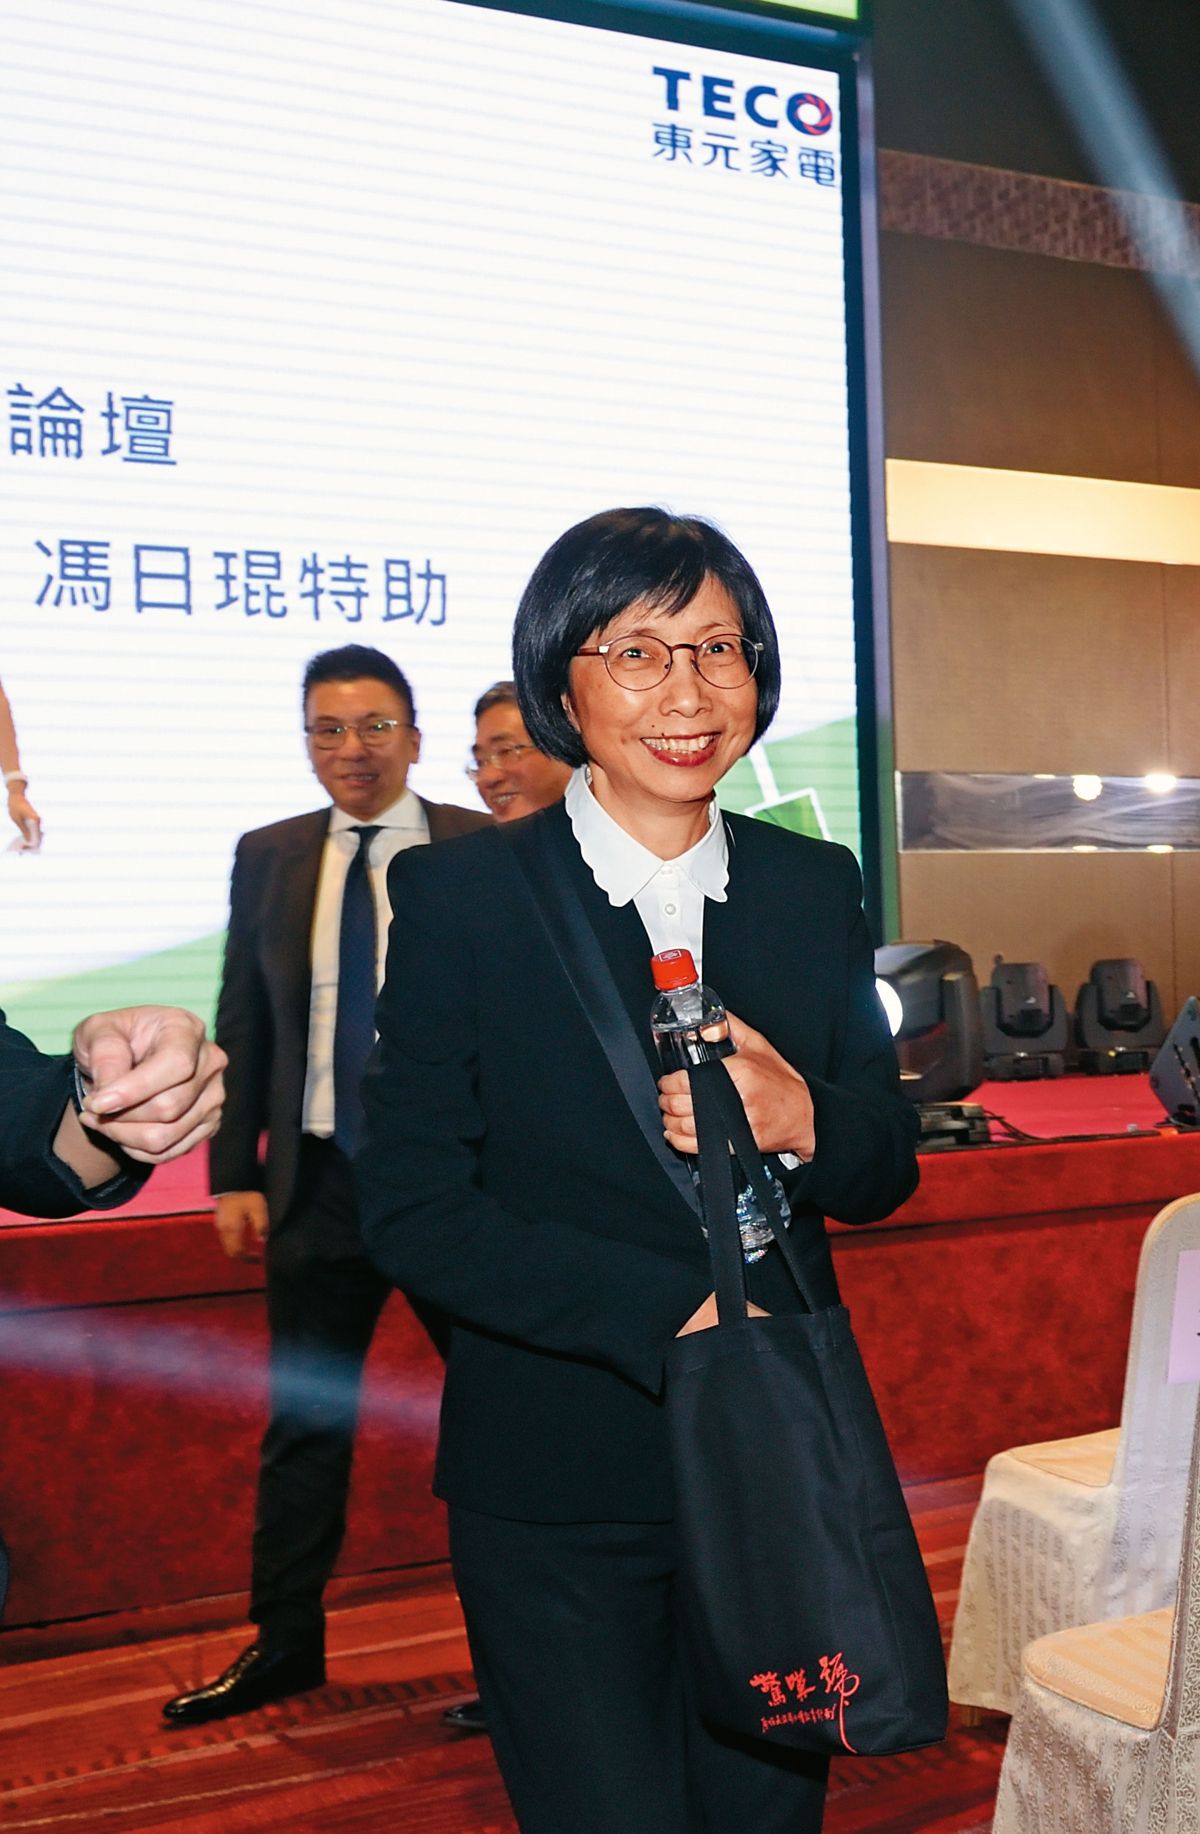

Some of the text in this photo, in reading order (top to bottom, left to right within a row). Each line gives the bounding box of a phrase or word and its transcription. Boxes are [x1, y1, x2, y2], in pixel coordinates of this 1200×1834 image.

[652, 66, 833, 136] TECO
[652, 123, 836, 187] 東元家電
[7, 383, 177, 465] 論壇
[35, 539, 447, 626] 馮日琨特助
